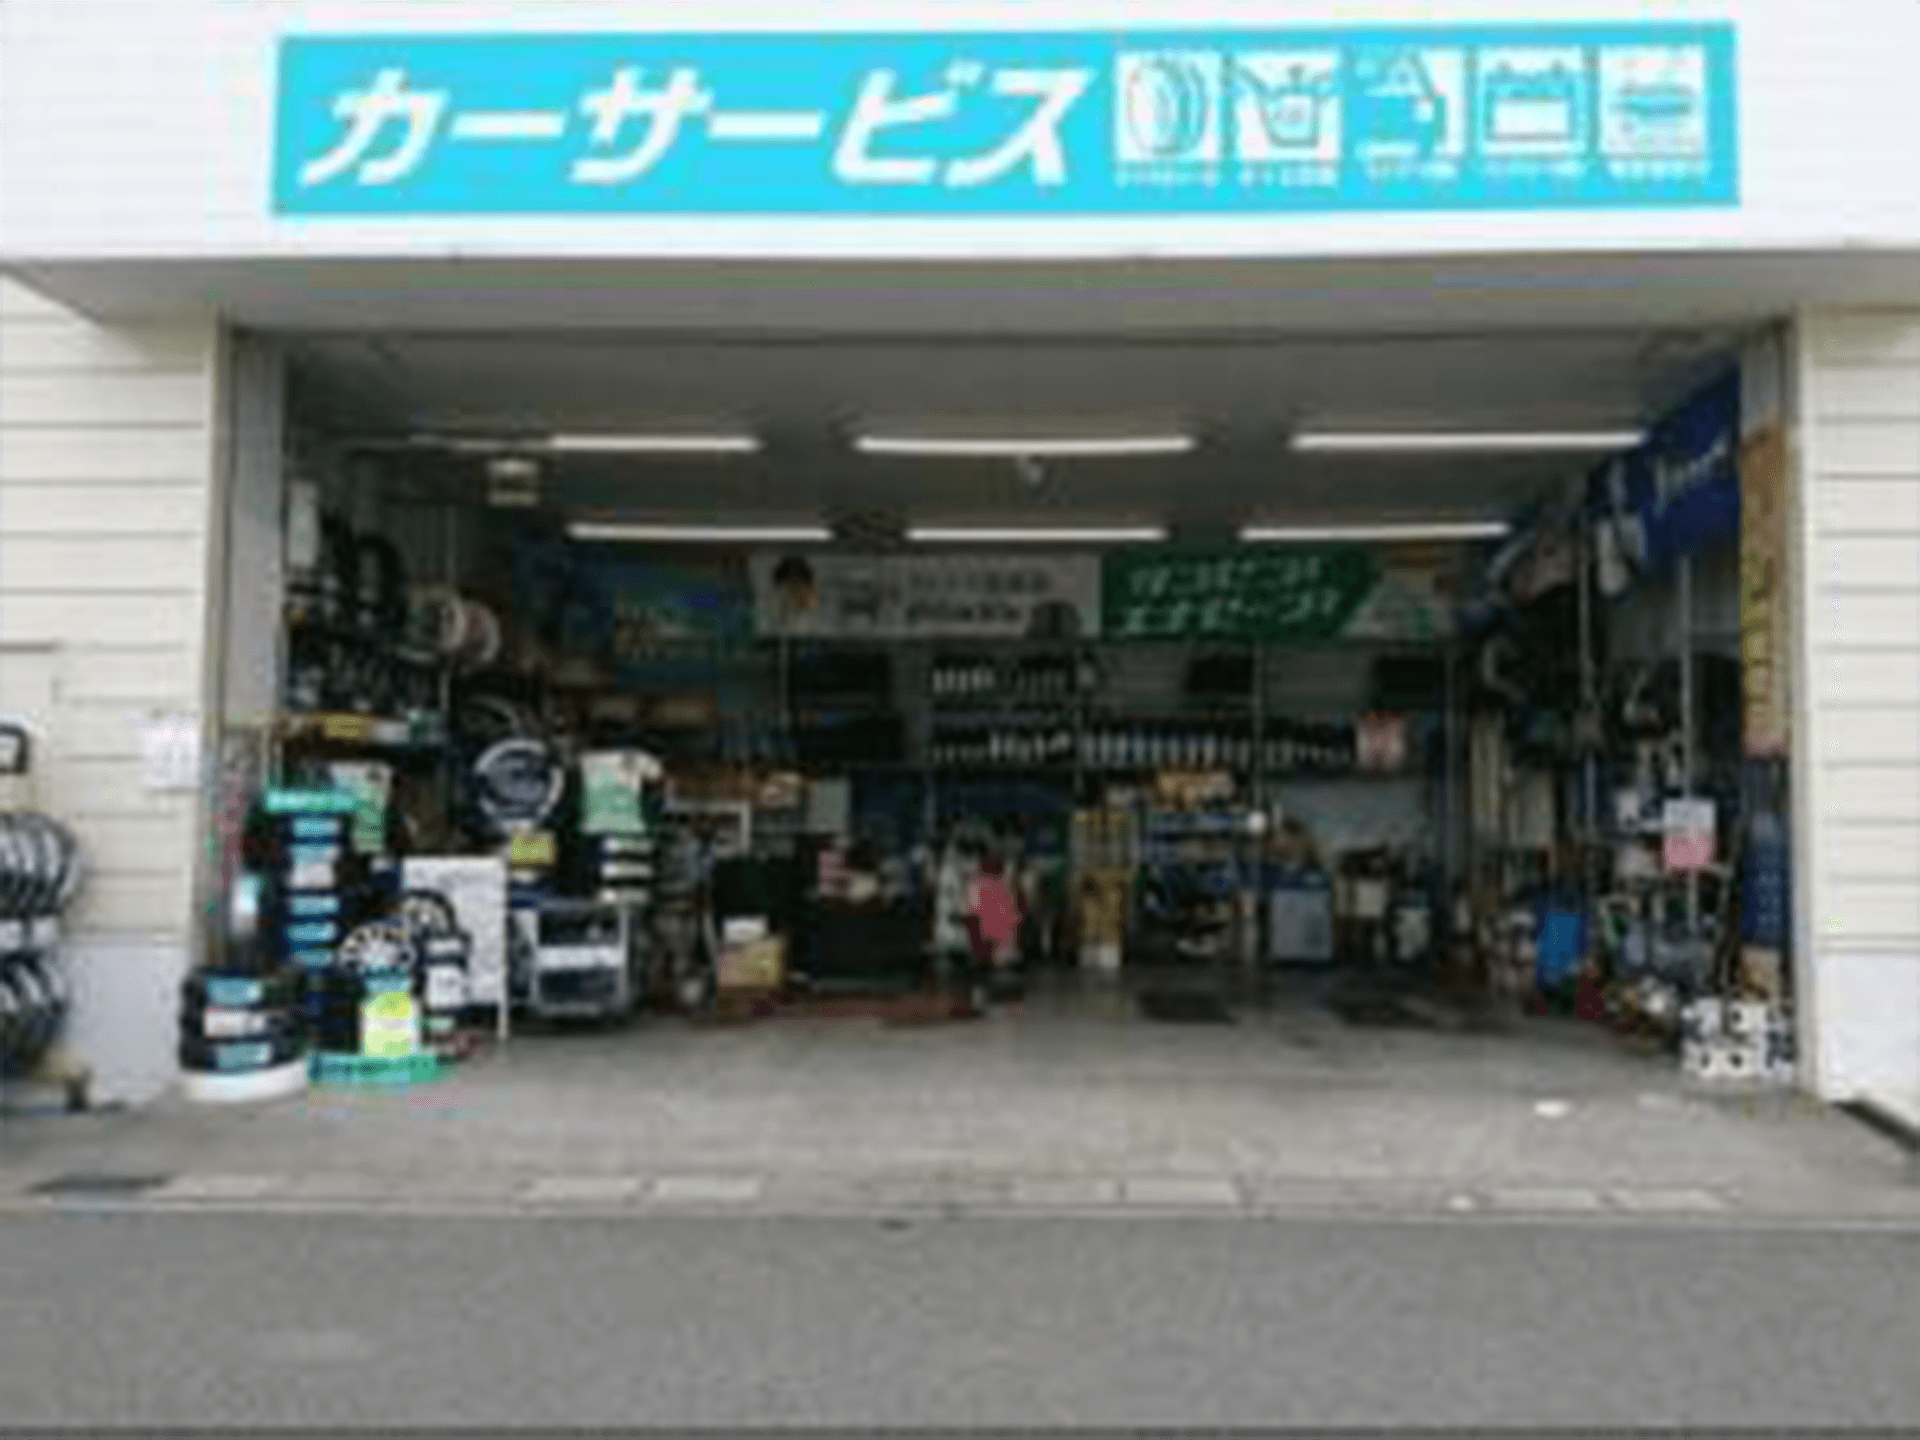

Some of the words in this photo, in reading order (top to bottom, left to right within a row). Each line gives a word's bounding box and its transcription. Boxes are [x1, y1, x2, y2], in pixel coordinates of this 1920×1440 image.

[300, 64, 1090, 186] カーサービス
